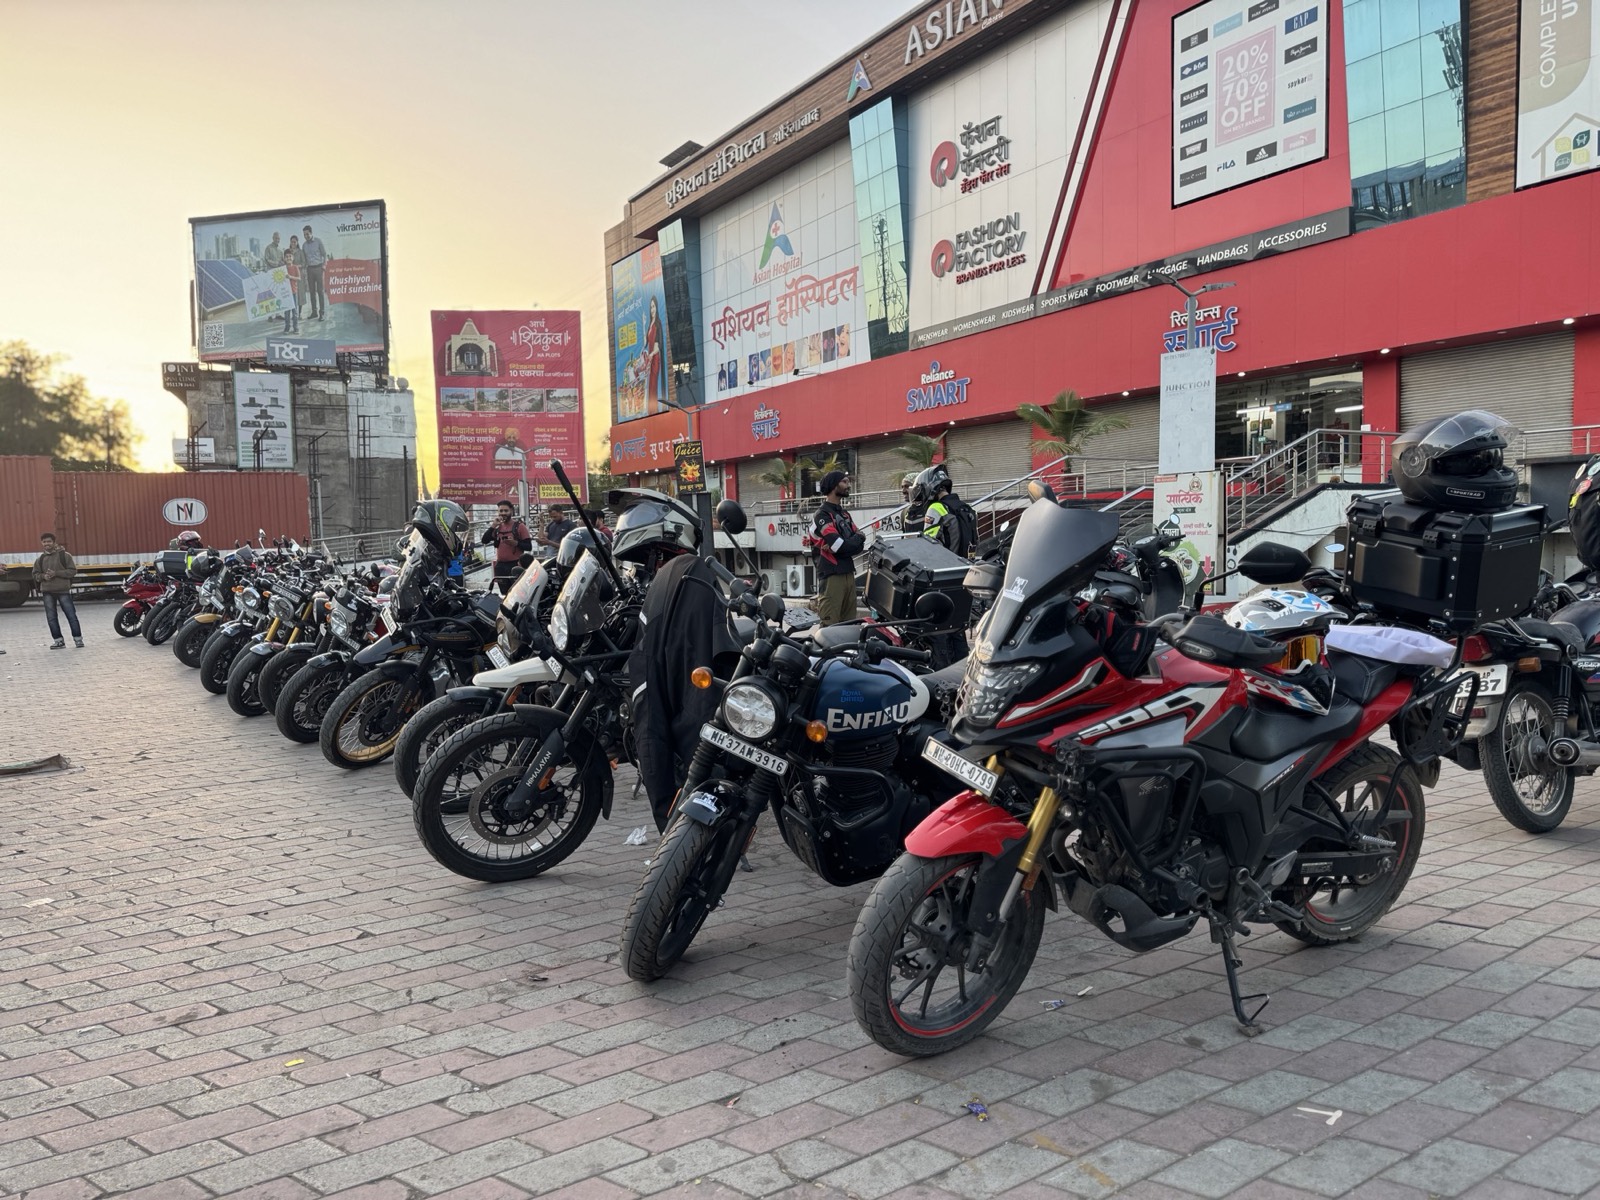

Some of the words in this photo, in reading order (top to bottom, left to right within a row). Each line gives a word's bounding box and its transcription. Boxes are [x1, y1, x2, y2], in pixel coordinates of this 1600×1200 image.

[1293, 12, 1309, 30] GAP
[1222, 39, 1269, 81] 20%
[1539, 0, 1557, 89] COMPLE
[1222, 68, 1268, 107] 70%
[1220, 96, 1267, 128] OFF
[959, 115, 1002, 150] फॅशन
[665, 171, 707, 209] एशियन
[707, 131, 768, 183] हॉस्पिटल
[960, 136, 1012, 177] फॅक्टरी
[1216, 159, 1236, 172] FILA
[336, 220, 381, 233] vikramsola
[955, 211, 1021, 252] FASHION
[955, 231, 1027, 272] FACTORY
[329, 275, 371, 286] Khushiyon
[752, 270, 771, 286] Asian
[772, 252, 803, 277] Hospital
[917, 328, 949, 342] MENSWEAR
[952, 314, 997, 333] WOMENSWEAR
[1001, 303, 1035, 319] KIDSWEAR
[1095, 273, 1139, 294] FOOTWEAR
[1196, 243, 1249, 266] HANDBAGS
[1257, 222, 1327, 250] ACCESSORIES
[956, 263, 988, 285] BRANDS
[988, 260, 1005, 275] FOR
[1006, 254, 1027, 269] LESS
[329, 285, 347, 295] wali
[348, 283, 383, 294] sunshine
[711, 300, 771, 350] एशियन
[775, 265, 860, 327] हॉस्पिटल
[269, 342, 309, 361] T&T
[163, 364, 195, 374] JOINT
[920, 368, 955, 385] Reliance
[906, 378, 971, 413] SMART
[1165, 380, 1211, 392] JUNCTION
[751, 410, 781, 441] स्मार्ट
[649, 439, 671, 460] सुपर
[674, 446, 702, 461] Juice
[710, 730, 725, 744] MH
[755, 751, 783, 773] 3916
[526, 751, 552, 787] HIMALAYAN
